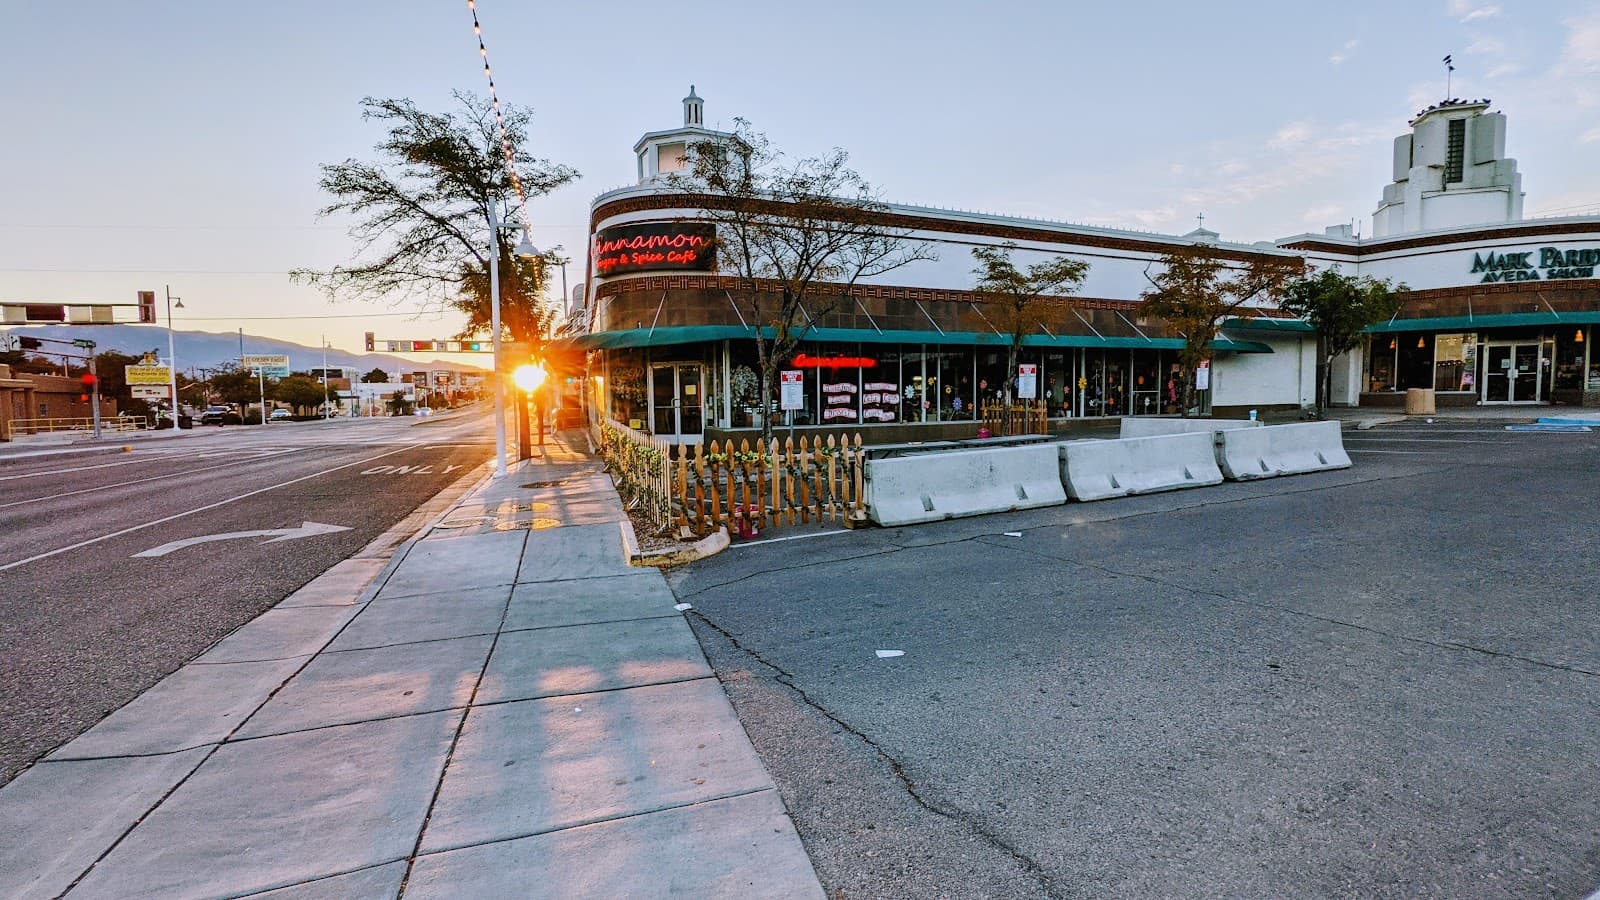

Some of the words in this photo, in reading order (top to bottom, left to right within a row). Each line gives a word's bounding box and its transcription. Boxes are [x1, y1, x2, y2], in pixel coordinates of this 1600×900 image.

[620, 253, 628, 265] &
[632, 251, 664, 265] Spice
[667, 249, 697, 264] Café
[1481, 270, 1541, 283] AVEDA
[1547, 267, 1594, 280] SALON
[360, 465, 464, 475] ONLY
